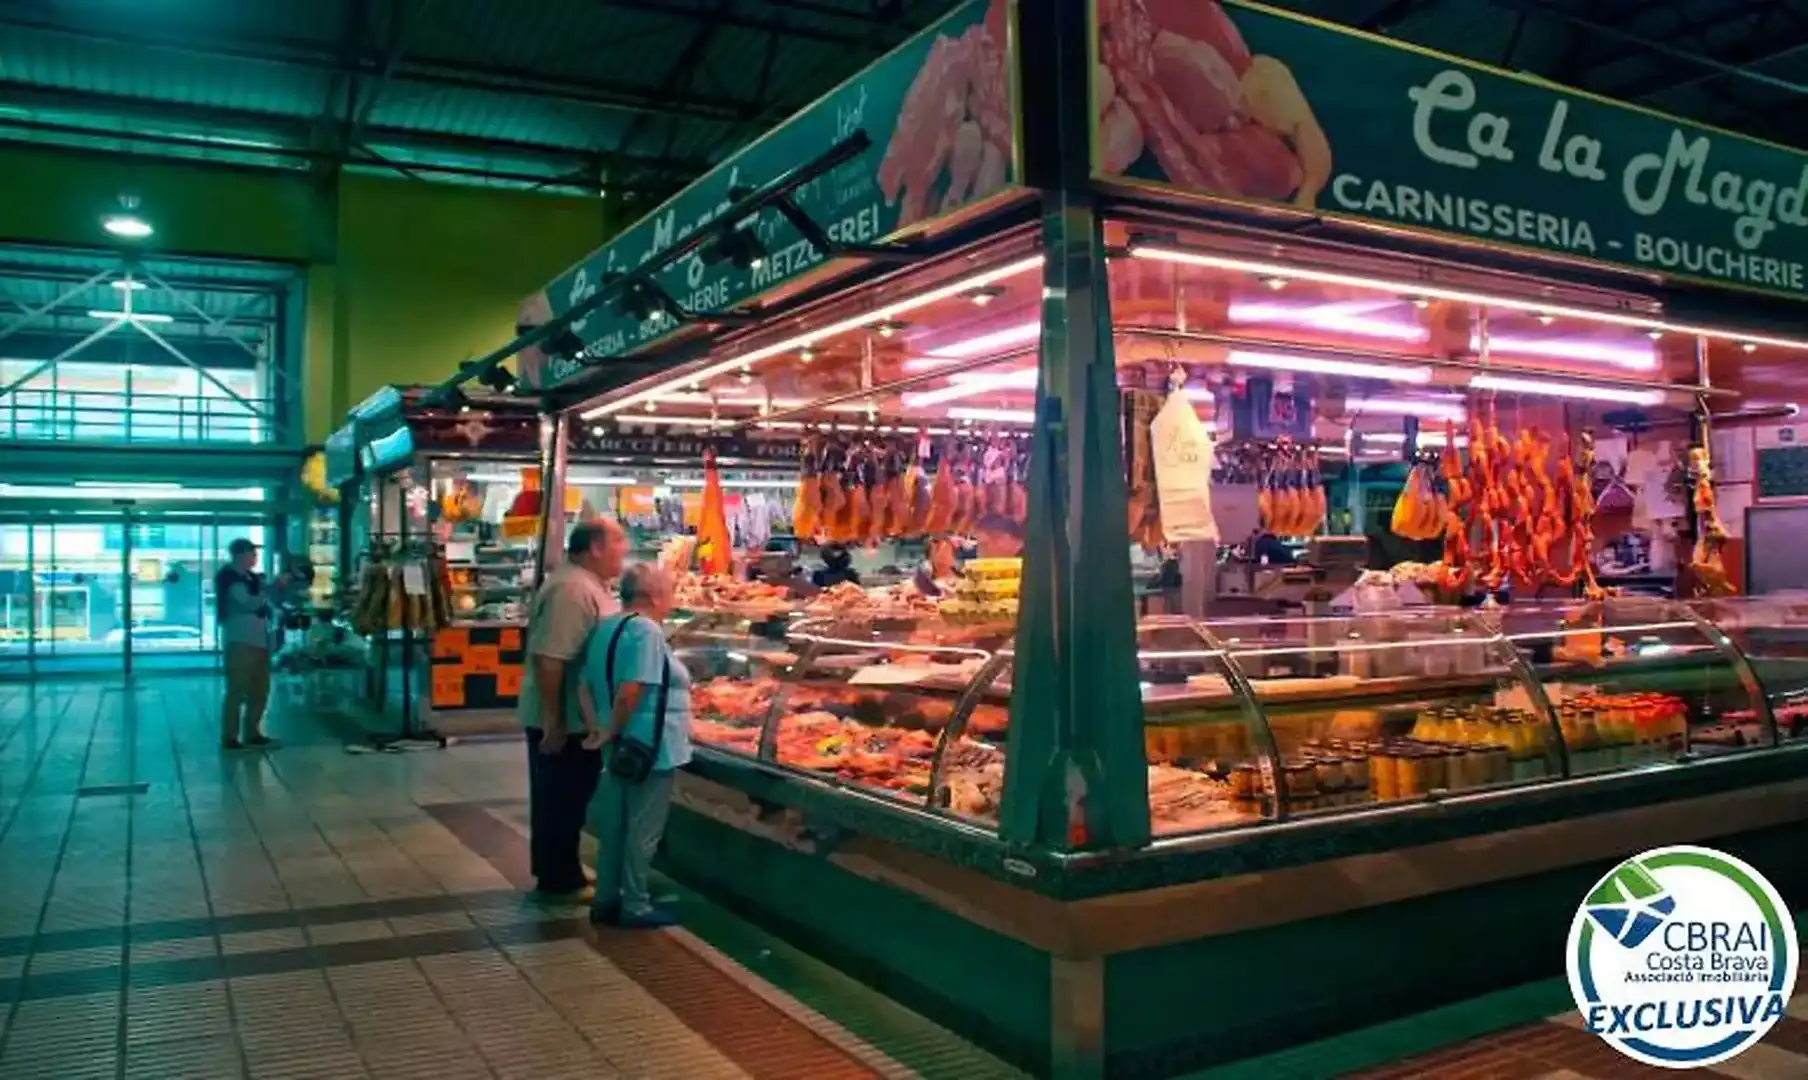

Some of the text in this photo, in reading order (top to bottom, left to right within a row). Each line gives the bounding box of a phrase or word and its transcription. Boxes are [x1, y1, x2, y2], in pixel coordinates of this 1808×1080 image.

[1333, 173, 1597, 255] CARNISSERIA
[1634, 232, 1804, 289] BOUCHERIE
[1408, 70, 1808, 249] Ca la Magd
